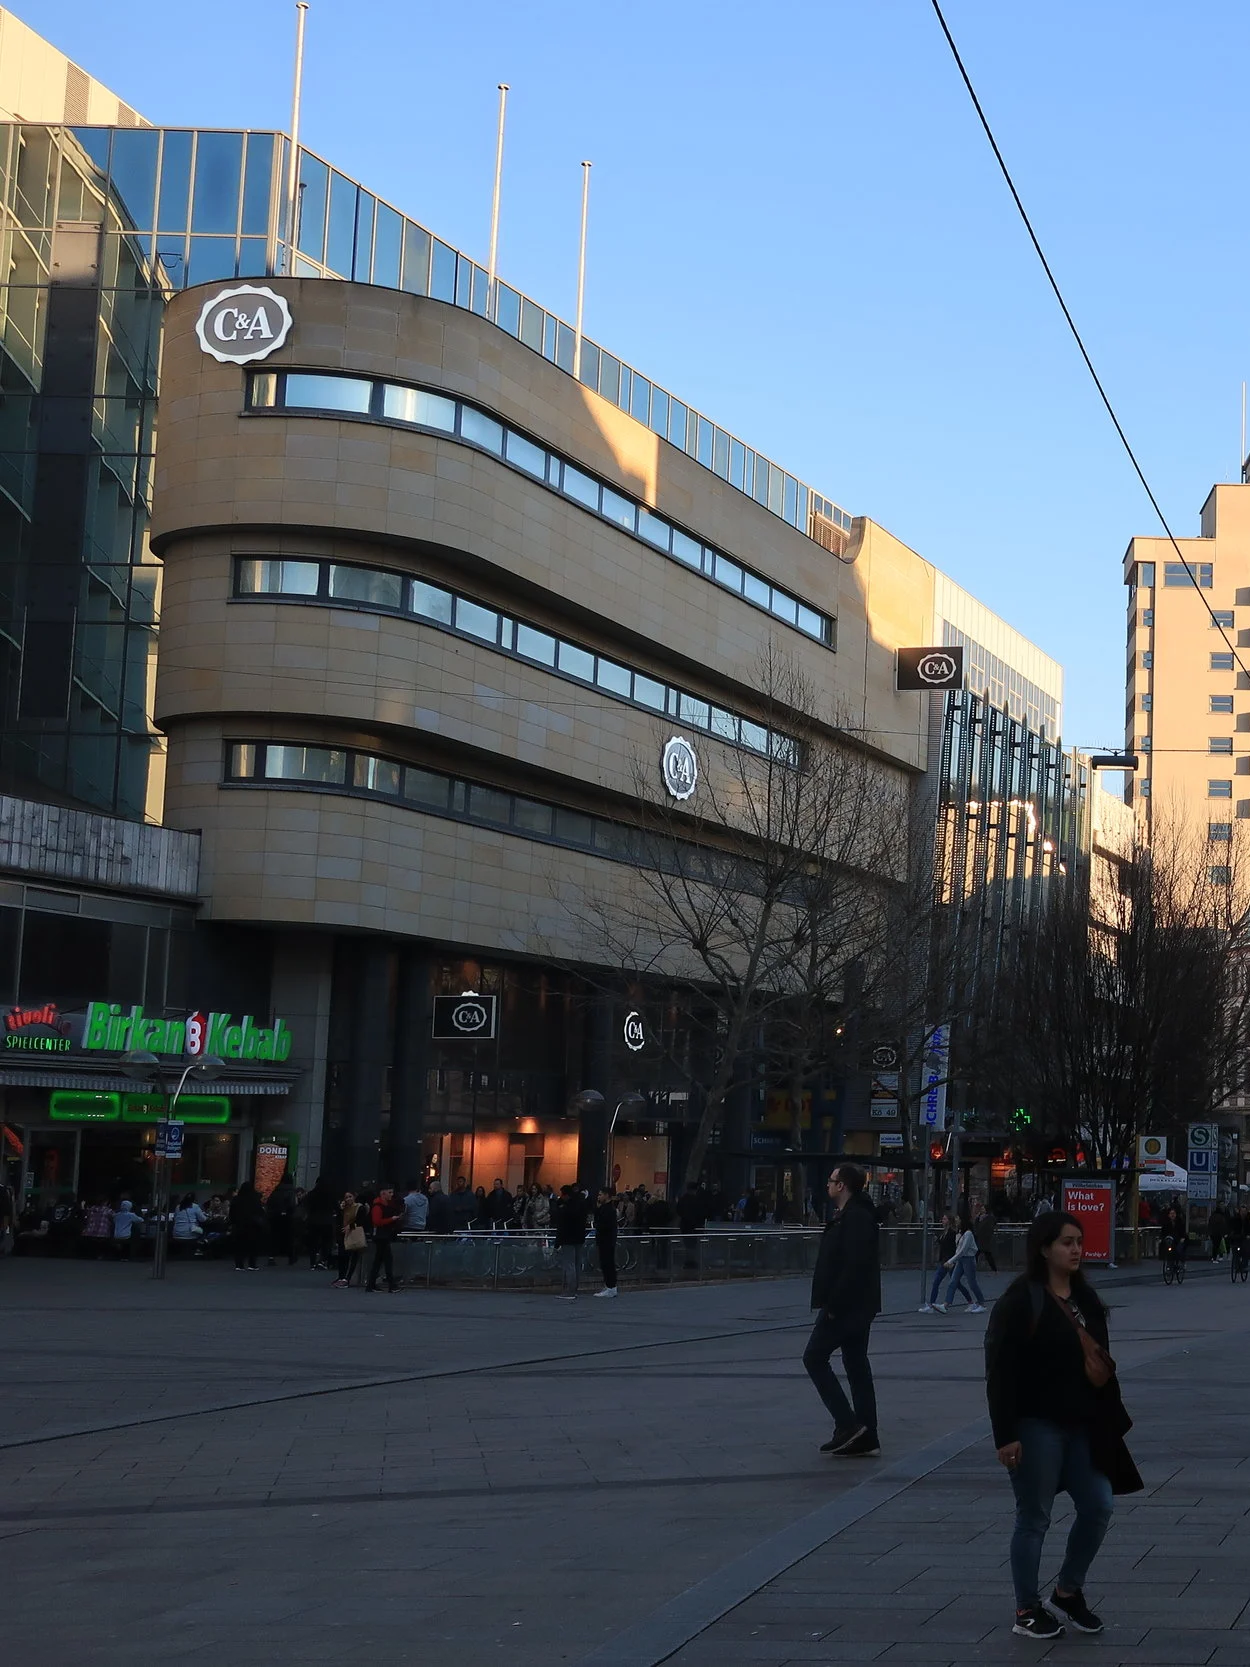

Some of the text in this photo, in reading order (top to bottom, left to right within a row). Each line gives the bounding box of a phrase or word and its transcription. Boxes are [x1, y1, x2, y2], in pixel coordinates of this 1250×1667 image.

[214, 306, 274, 341] C&A
[924, 661, 950, 675] C&A
[669, 752, 692, 785] C&A
[458, 1010, 480, 1024] C&A
[82, 1001, 186, 1055] Birkan
[204, 1012, 293, 1062] Kebab
[628, 1022, 644, 1040] C&A
[5, 1035, 71, 1051] SPIELCENTER
[886, 1108, 896, 1117] 49
[1193, 1152, 1205, 1167] U
[1068, 1191, 1094, 1200] What
[1068, 1202, 1104, 1211] is love?
